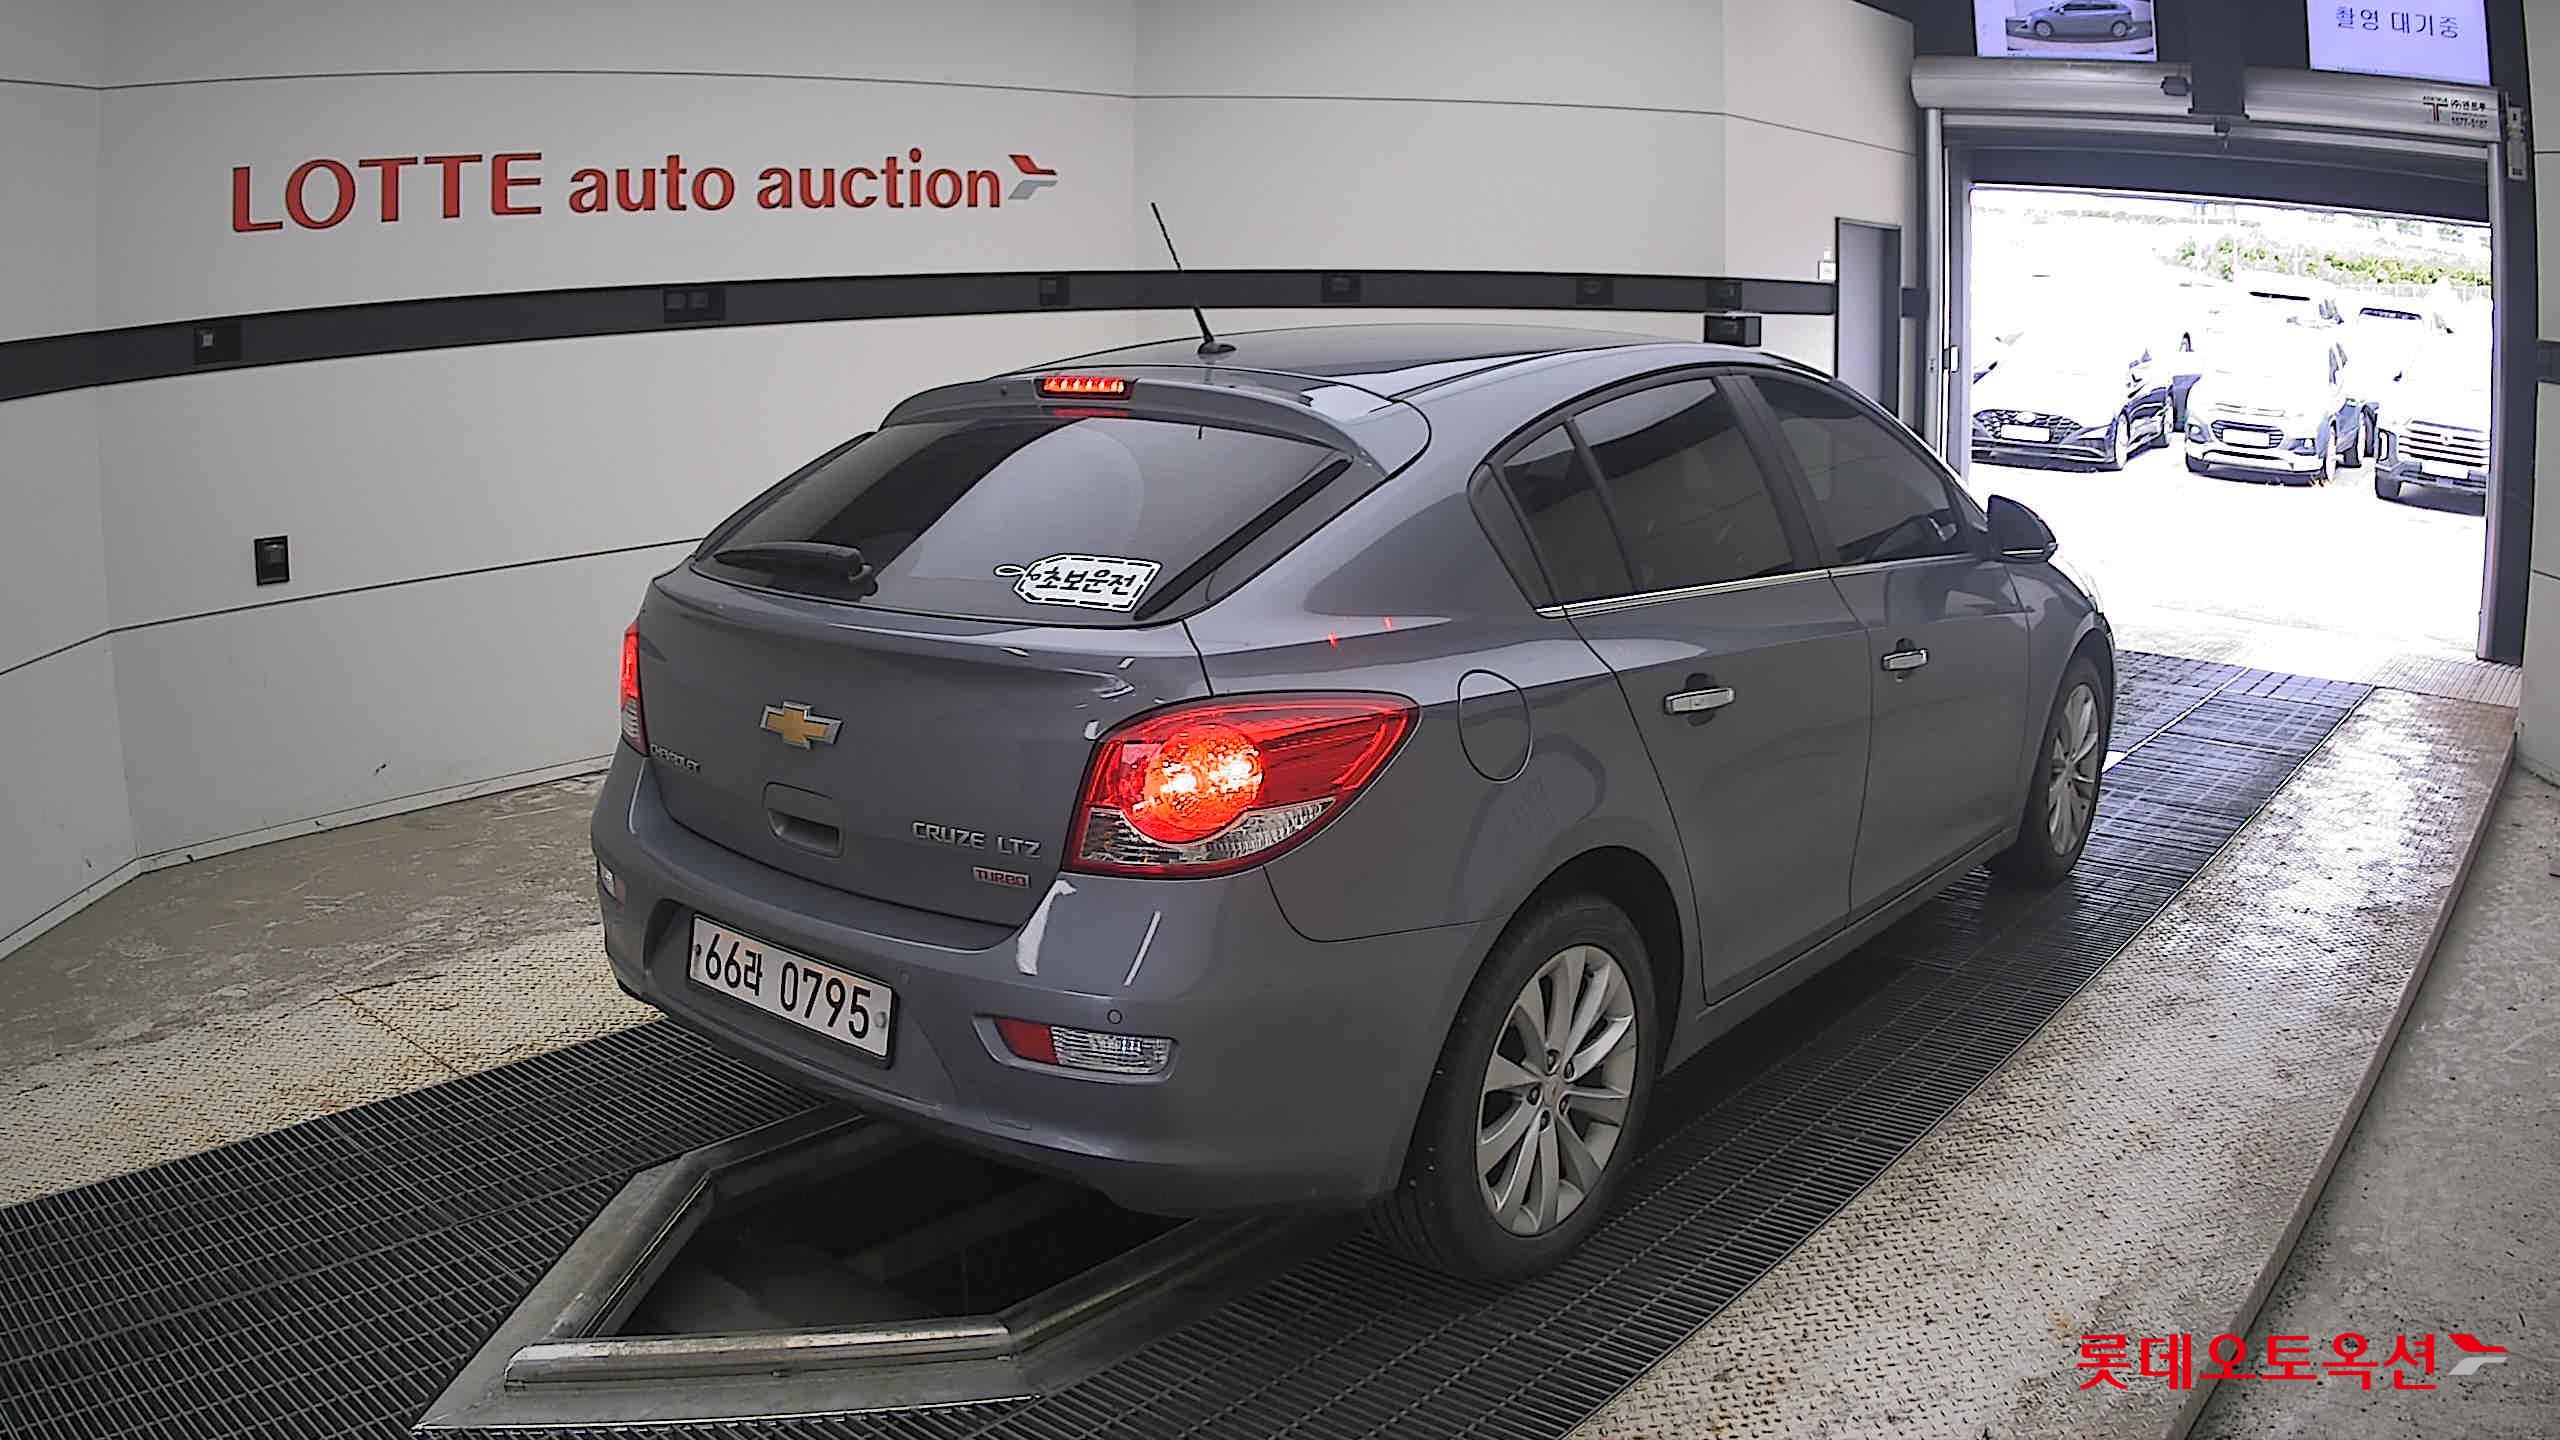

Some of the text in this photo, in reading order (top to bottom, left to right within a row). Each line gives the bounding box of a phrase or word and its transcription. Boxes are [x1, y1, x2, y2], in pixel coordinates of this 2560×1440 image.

[2336, 7, 2458, 39] 촬영 대기중
[232, 147, 1001, 233] LOTTE auto auction
[1034, 566, 1137, 596] 초보운전
[912, 821, 1041, 859] CRUZE LTZ
[975, 868, 1027, 888] TURBO
[705, 933, 871, 1039] 66라 0795
